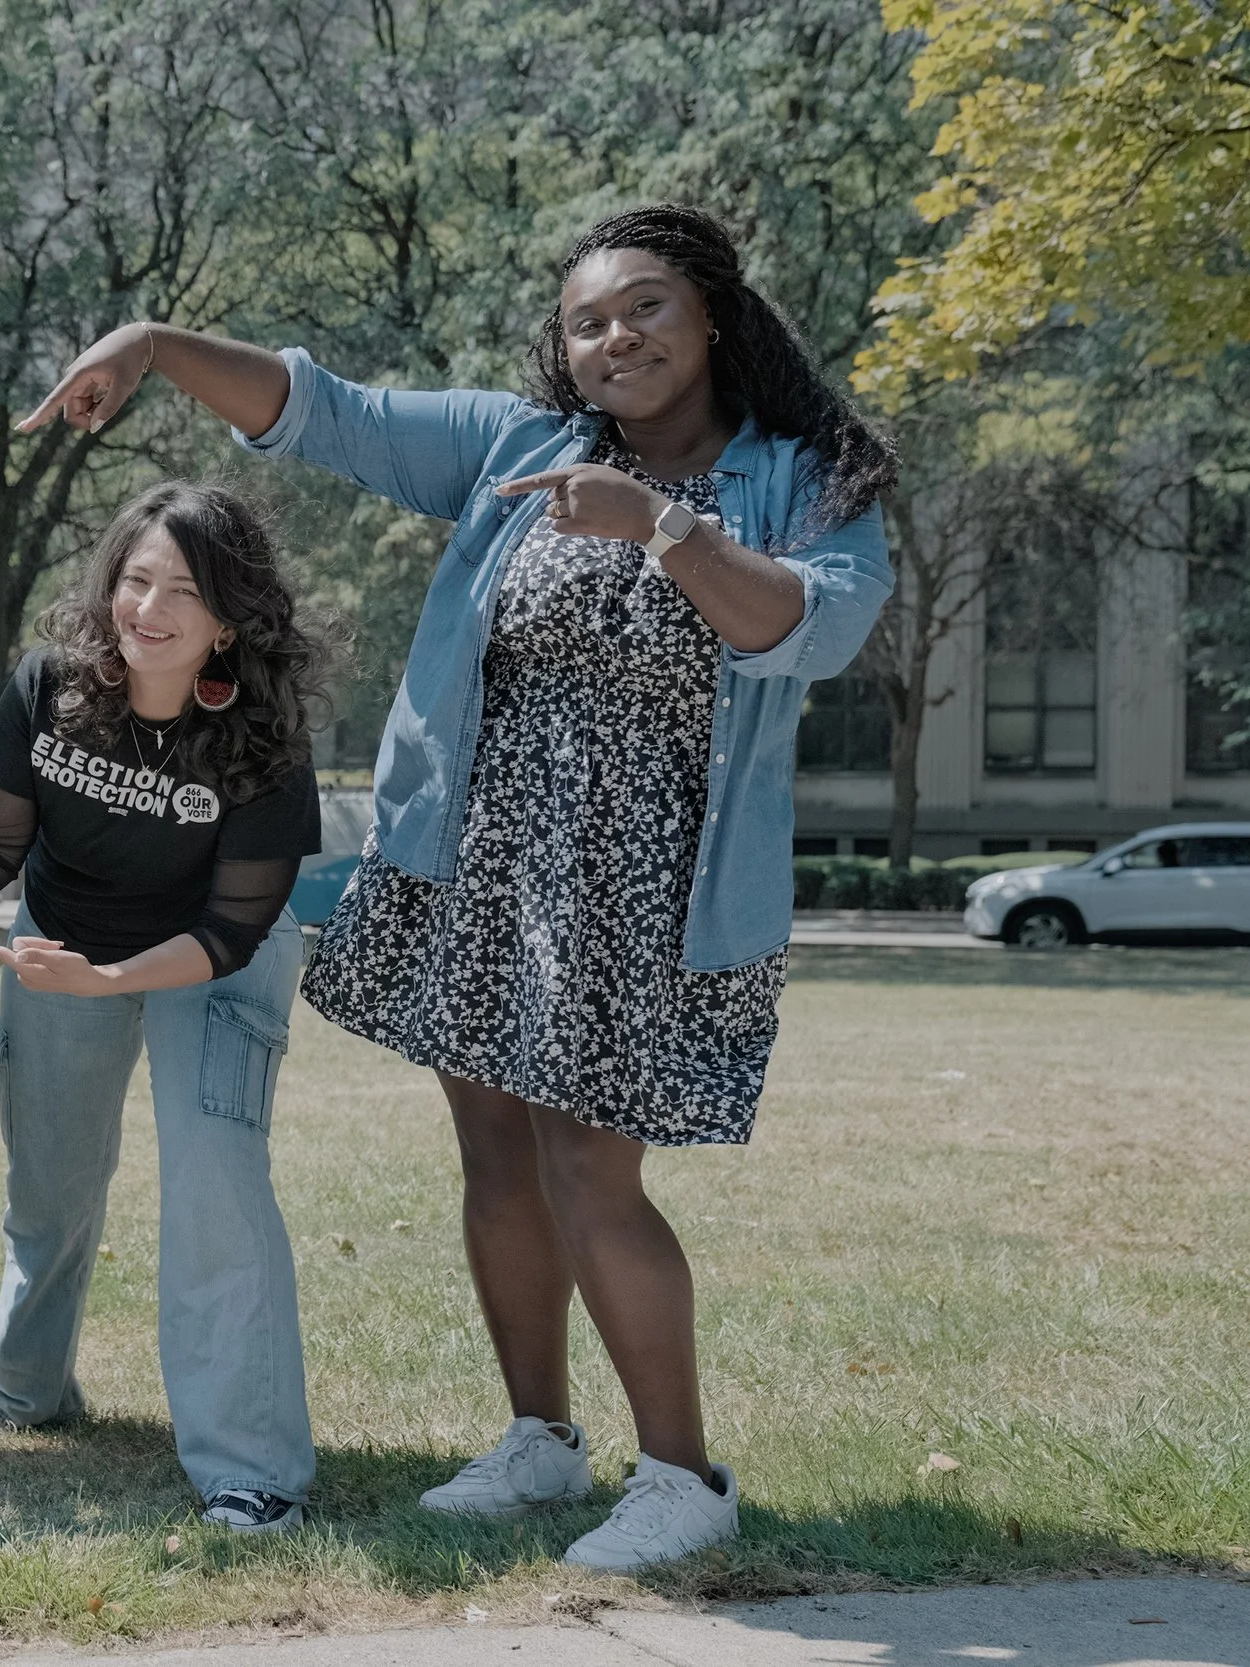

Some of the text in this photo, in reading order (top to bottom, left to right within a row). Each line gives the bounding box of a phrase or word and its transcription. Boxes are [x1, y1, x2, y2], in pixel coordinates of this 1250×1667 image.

[32, 732, 175, 797] ELECTION
[31, 751, 168, 818] PROTECTION
[185, 787, 202, 796] 866
[180, 796, 213, 810] OUR
[187, 809, 213, 819] VOTE
